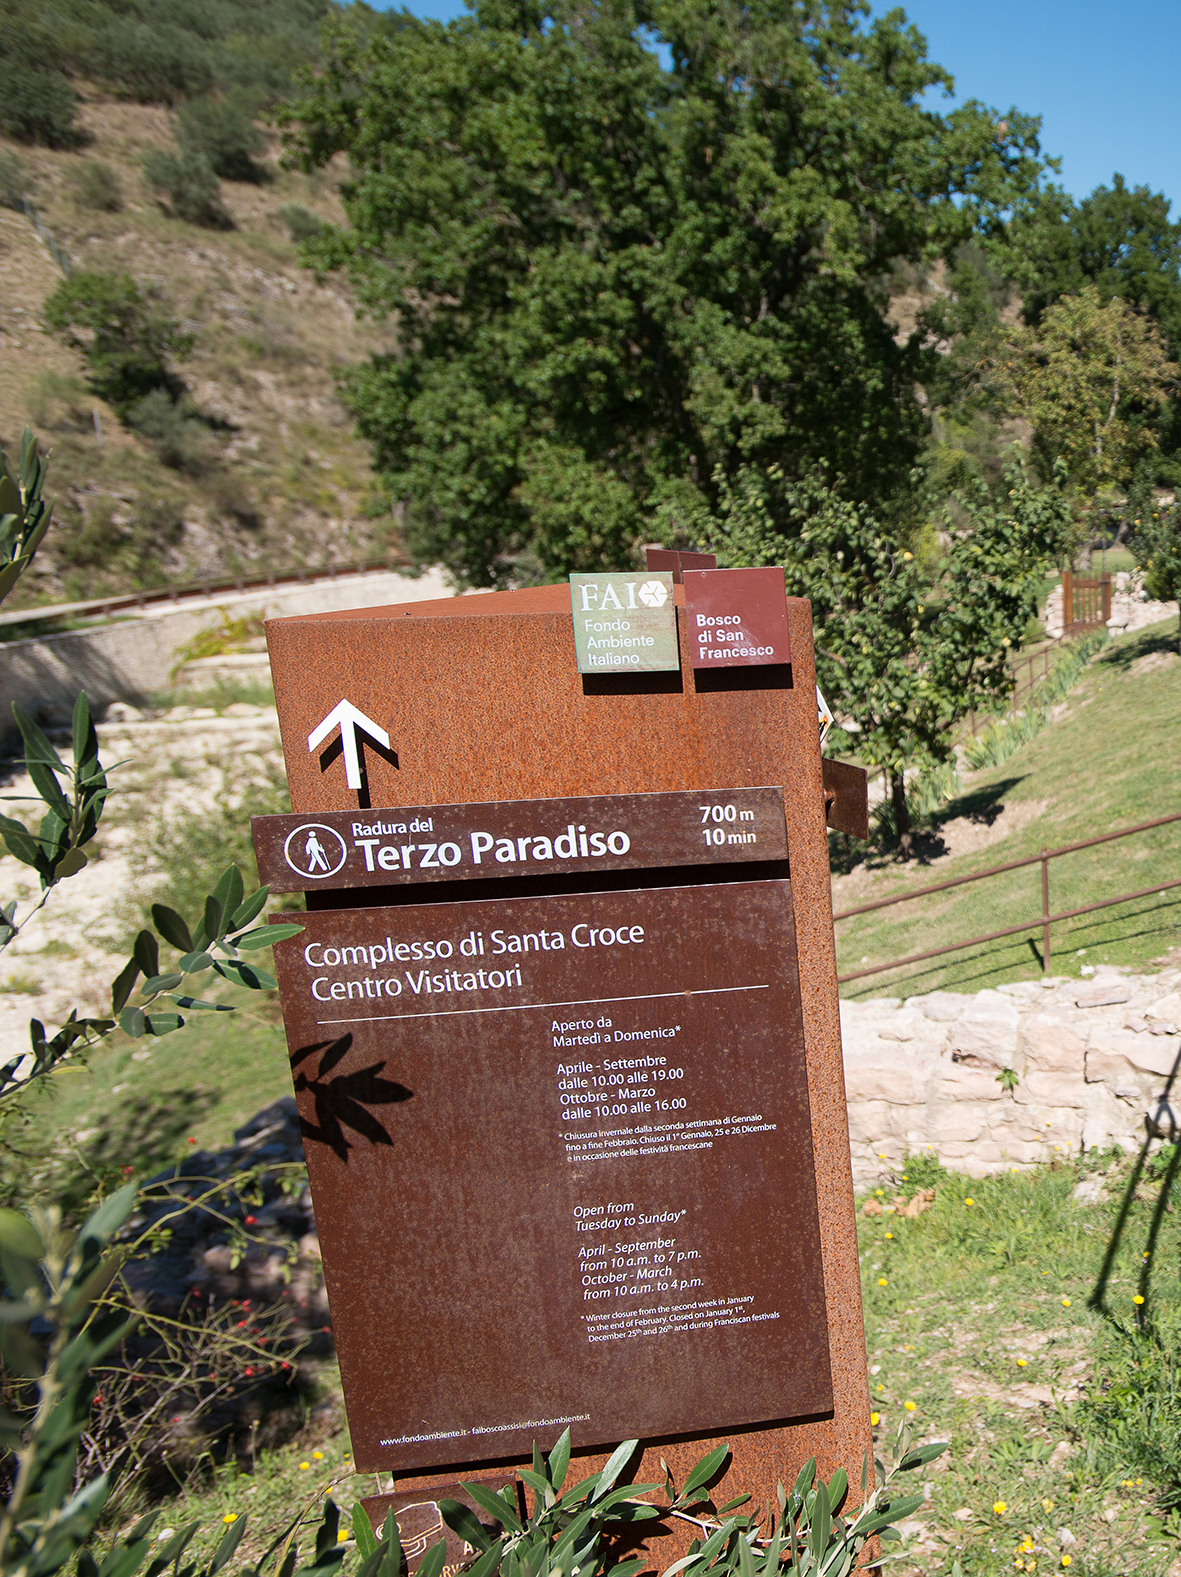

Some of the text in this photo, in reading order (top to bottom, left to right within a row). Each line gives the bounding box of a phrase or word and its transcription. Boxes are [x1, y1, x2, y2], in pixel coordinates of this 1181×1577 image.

[578, 582, 638, 611] FAI
[584, 618, 630, 632] Fondo
[696, 614, 741, 627] Bosco
[587, 634, 654, 649] Ambiente
[698, 629, 744, 643] di San
[588, 652, 640, 666] Italiano
[699, 644, 774, 660] Francesco
[699, 804, 754, 823] 700 m
[352, 817, 433, 837] Radura del
[702, 828, 756, 846] 10 min
[354, 824, 630, 872] Terzo Paradiso
[304, 923, 644, 969] Complesso di Santa Croce
[312, 963, 522, 1001] Centro Visitatori
[551, 1016, 612, 1034] Aperto da
[553, 1032, 601, 1047] Martedì
[604, 1034, 611, 1043] a
[557, 1061, 593, 1077] Aprile
[603, 1055, 667, 1071] Settembre
[558, 1068, 684, 1090] dalle 10.00 alle 19.00
[560, 1091, 608, 1105] Ottobre
[618, 1088, 656, 1099] Marzo
[562, 1098, 687, 1120] dalle 10.00 alle 16.00
[564, 1132, 598, 1141] Chiusura
[598, 1127, 633, 1137] invernale
[634, 1125, 652, 1134] dalla
[653, 1122, 684, 1132] seconda
[685, 1119, 722, 1129] settimana
[723, 1116, 730, 1125] di
[731, 1114, 762, 1124] Gennaio
[565, 1143, 581, 1151] fino
[588, 1141, 603, 1149] fine
[604, 1138, 639, 1148] Febbraio.
[639, 1136, 665, 1144] Chiuso
[666, 1133, 671, 1141] il
[680, 1130, 714, 1140] Gennaio,
[714, 1128, 724, 1136] 25
[731, 1126, 741, 1134] 26
[741, 1123, 777, 1133] Dicembre
[573, 1154, 581, 1162] in
[581, 1151, 619, 1161] occasione
[620, 1148, 639, 1157] delle
[639, 1145, 669, 1155] festività
[669, 1141, 713, 1152] francescane
[573, 1202, 634, 1219] Open from
[575, 1217, 622, 1232] Tuesday
[624, 1217, 636, 1226] to
[578, 1244, 605, 1259] April
[615, 1237, 676, 1255] September
[580, 1250, 701, 1272] from 10 a.m. to 7 p.m.
[582, 1272, 628, 1286] October
[636, 1265, 672, 1280] March
[584, 1278, 704, 1300] from 10 a.m. to 4 p.m.
[585, 1314, 611, 1322] Winter
[611, 1310, 638, 1319] closure
[657, 1305, 670, 1313] the
[671, 1301, 697, 1312] second
[697, 1299, 718, 1308] week
[726, 1295, 754, 1305] January
[610, 1320, 625, 1330] end
[625, 1319, 634, 1328] of
[634, 1317, 668, 1326] February.
[668, 1312, 693, 1322] Closed
[705, 1308, 733, 1318] January
[588, 1332, 626, 1343] December
[642, 1327, 658, 1336] and
[674, 1323, 688, 1332] and
[689, 1321, 713, 1330] during
[714, 1316, 751, 1326] Franciscan
[751, 1311, 780, 1321] festivals
[380, 1429, 467, 1446] www.fondoambiente.it
[472, 1414, 590, 1434] faiboscoassisi@fondoambiente.it
